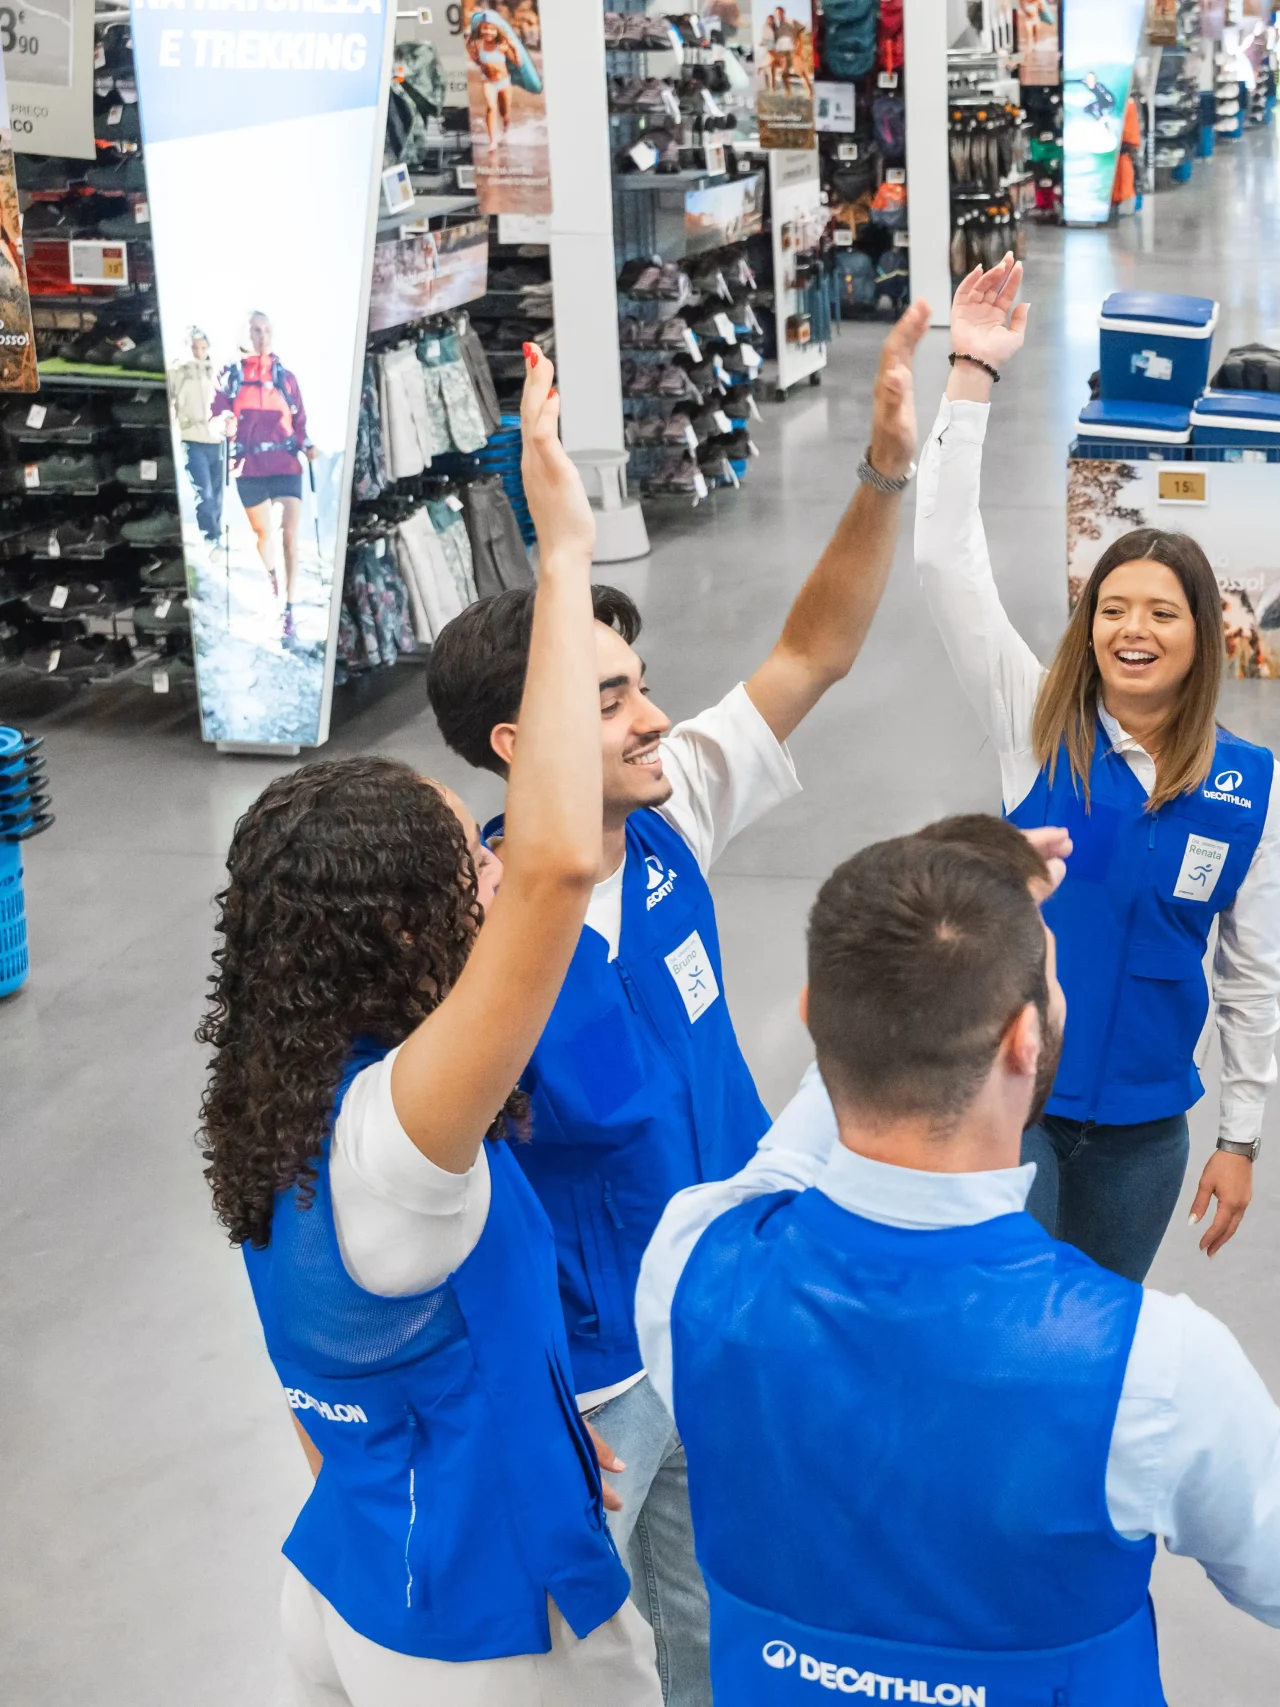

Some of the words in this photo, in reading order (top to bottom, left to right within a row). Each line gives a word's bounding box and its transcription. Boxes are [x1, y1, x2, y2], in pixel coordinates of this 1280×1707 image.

[159, 29, 184, 68] E
[190, 30, 367, 71] TREKKING
[0, 331, 30, 346] osso!
[1217, 572, 1265, 591] osso!
[1203, 789, 1252, 809] DECATHLON
[1189, 844, 1222, 861] Renata
[672, 949, 697, 975] Bruno
[284, 1387, 369, 1423] ECATHLON
[800, 1652, 987, 1707] DECATHLON
